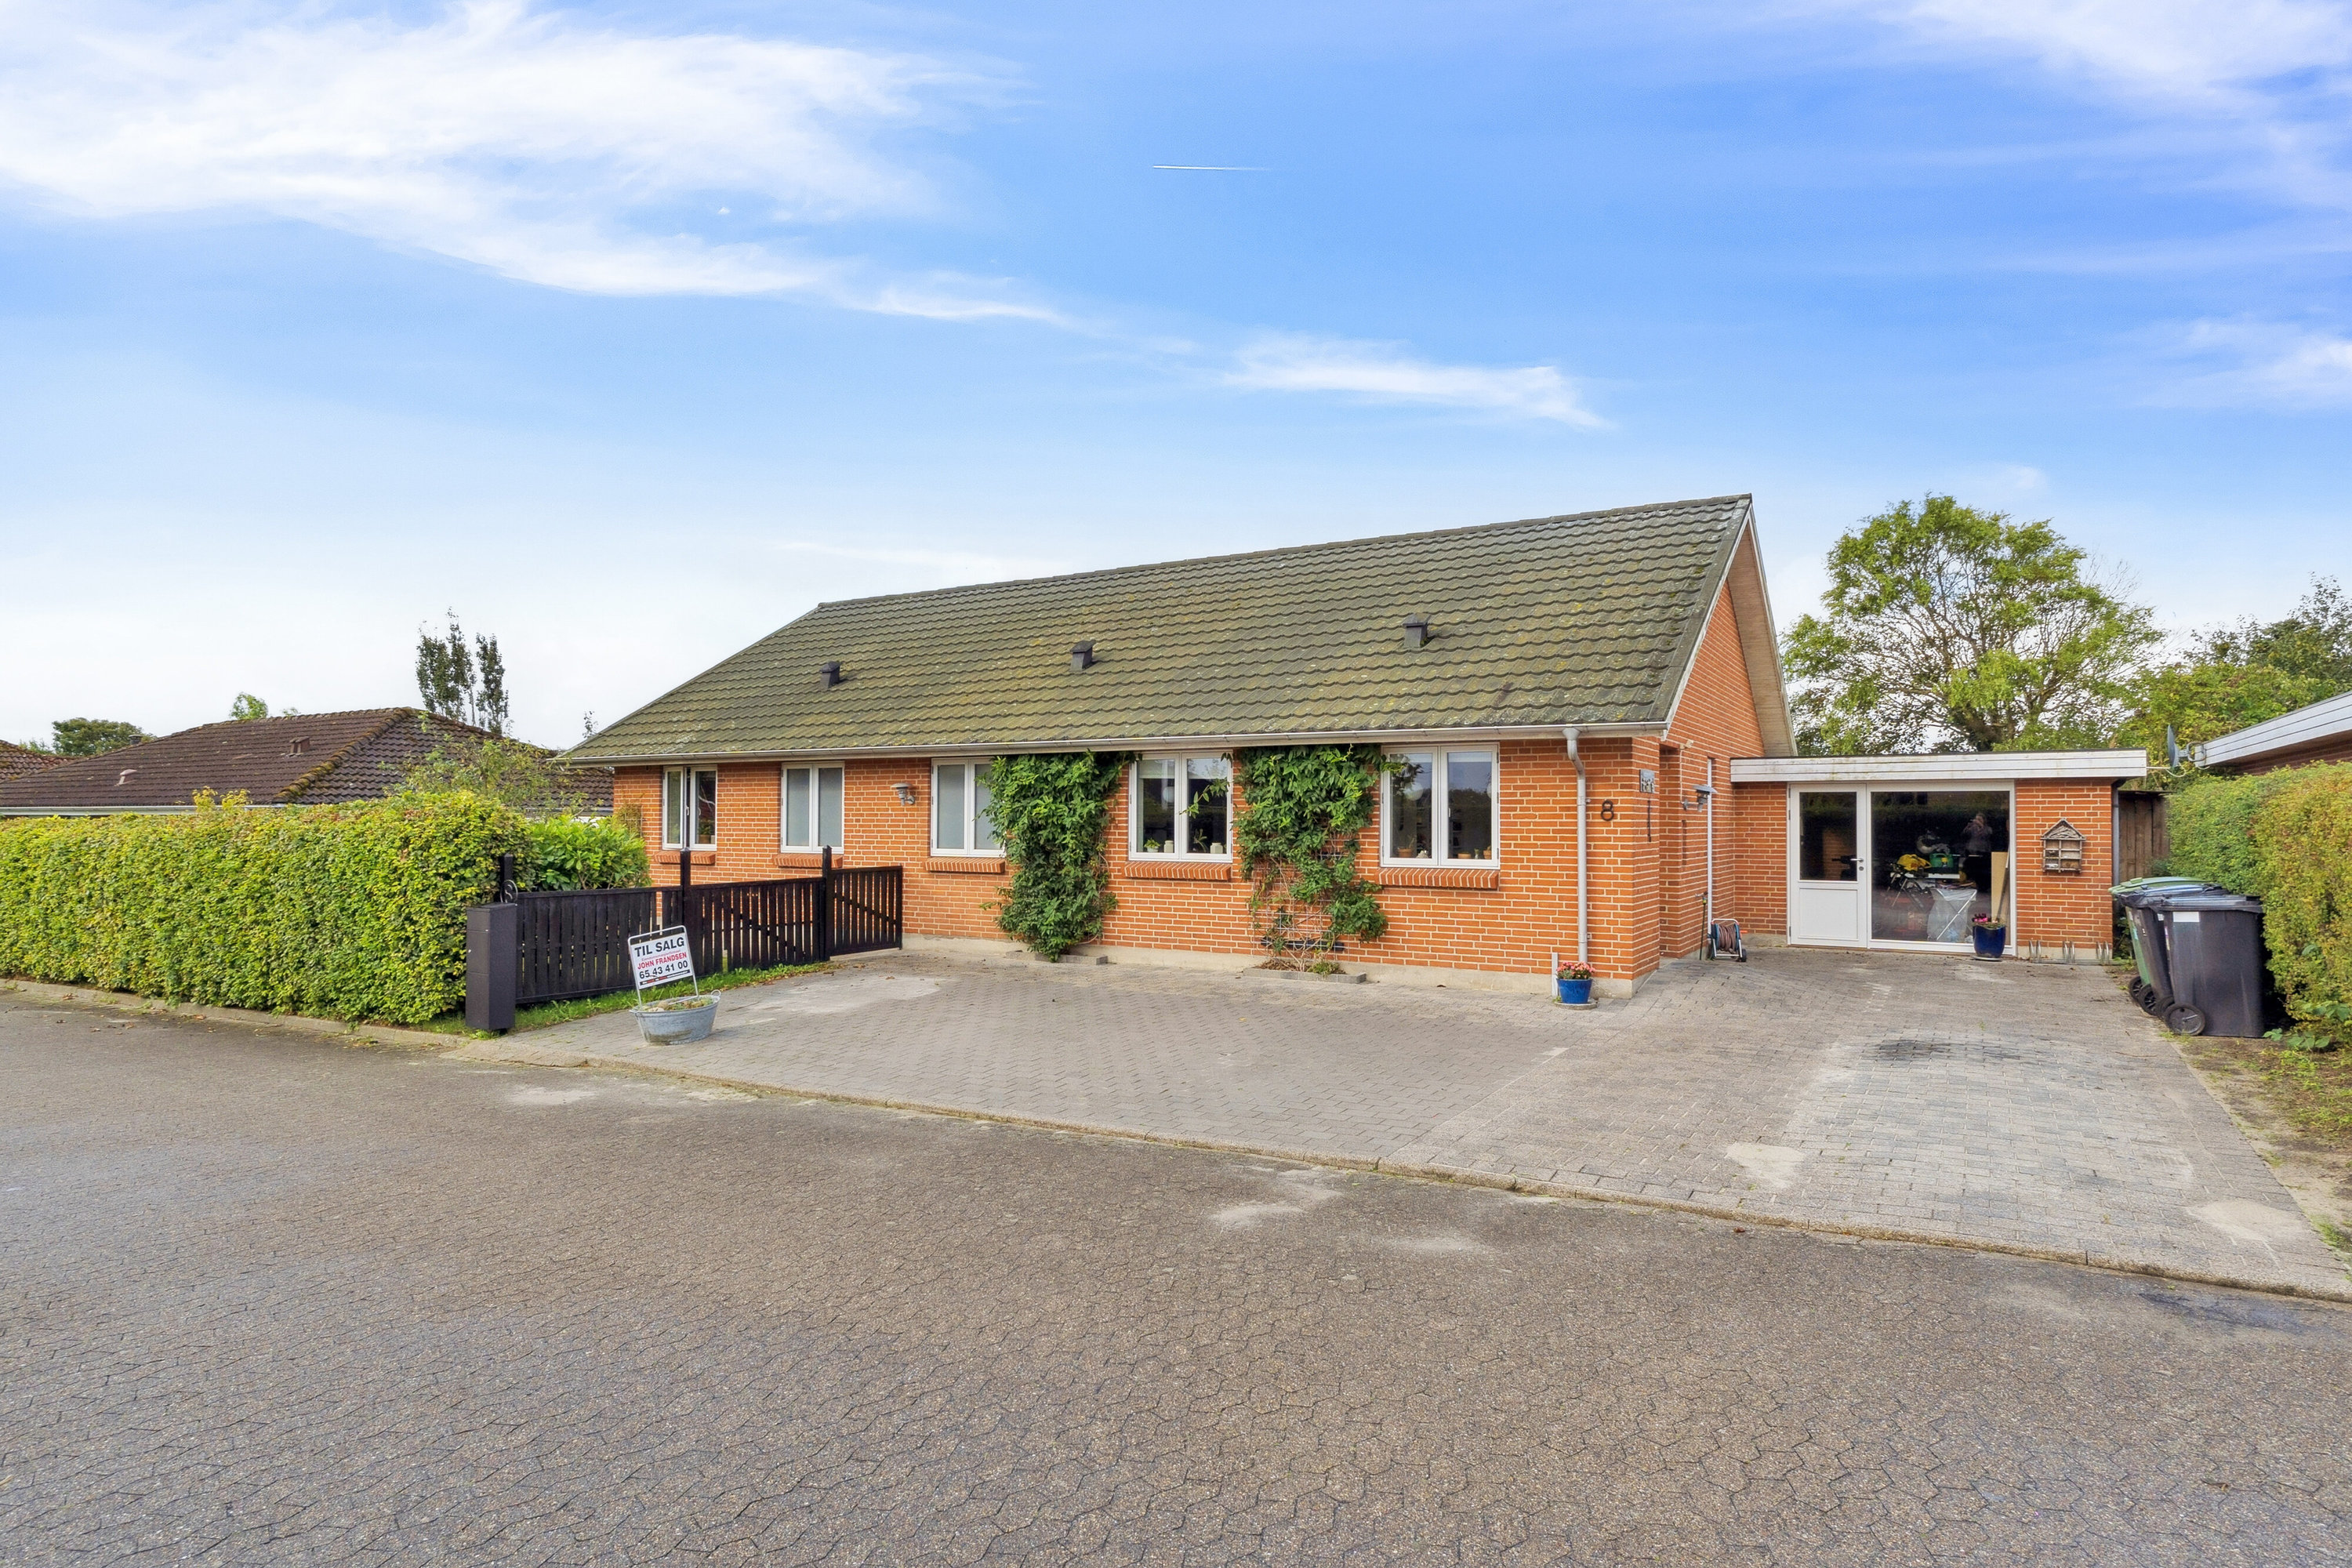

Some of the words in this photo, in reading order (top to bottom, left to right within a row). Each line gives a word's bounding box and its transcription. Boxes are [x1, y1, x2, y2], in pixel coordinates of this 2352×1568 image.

[1601, 800, 1614, 822] 8
[634, 945, 652, 957] TIL
[655, 937, 684, 952] SALG
[637, 960, 654, 970] JOHN
[655, 953, 687, 965] FRANDSEN
[639, 970, 650, 979] 65
[652, 967, 662, 975] 43
[666, 964, 674, 972] 41
[677, 960, 688, 969] 00
